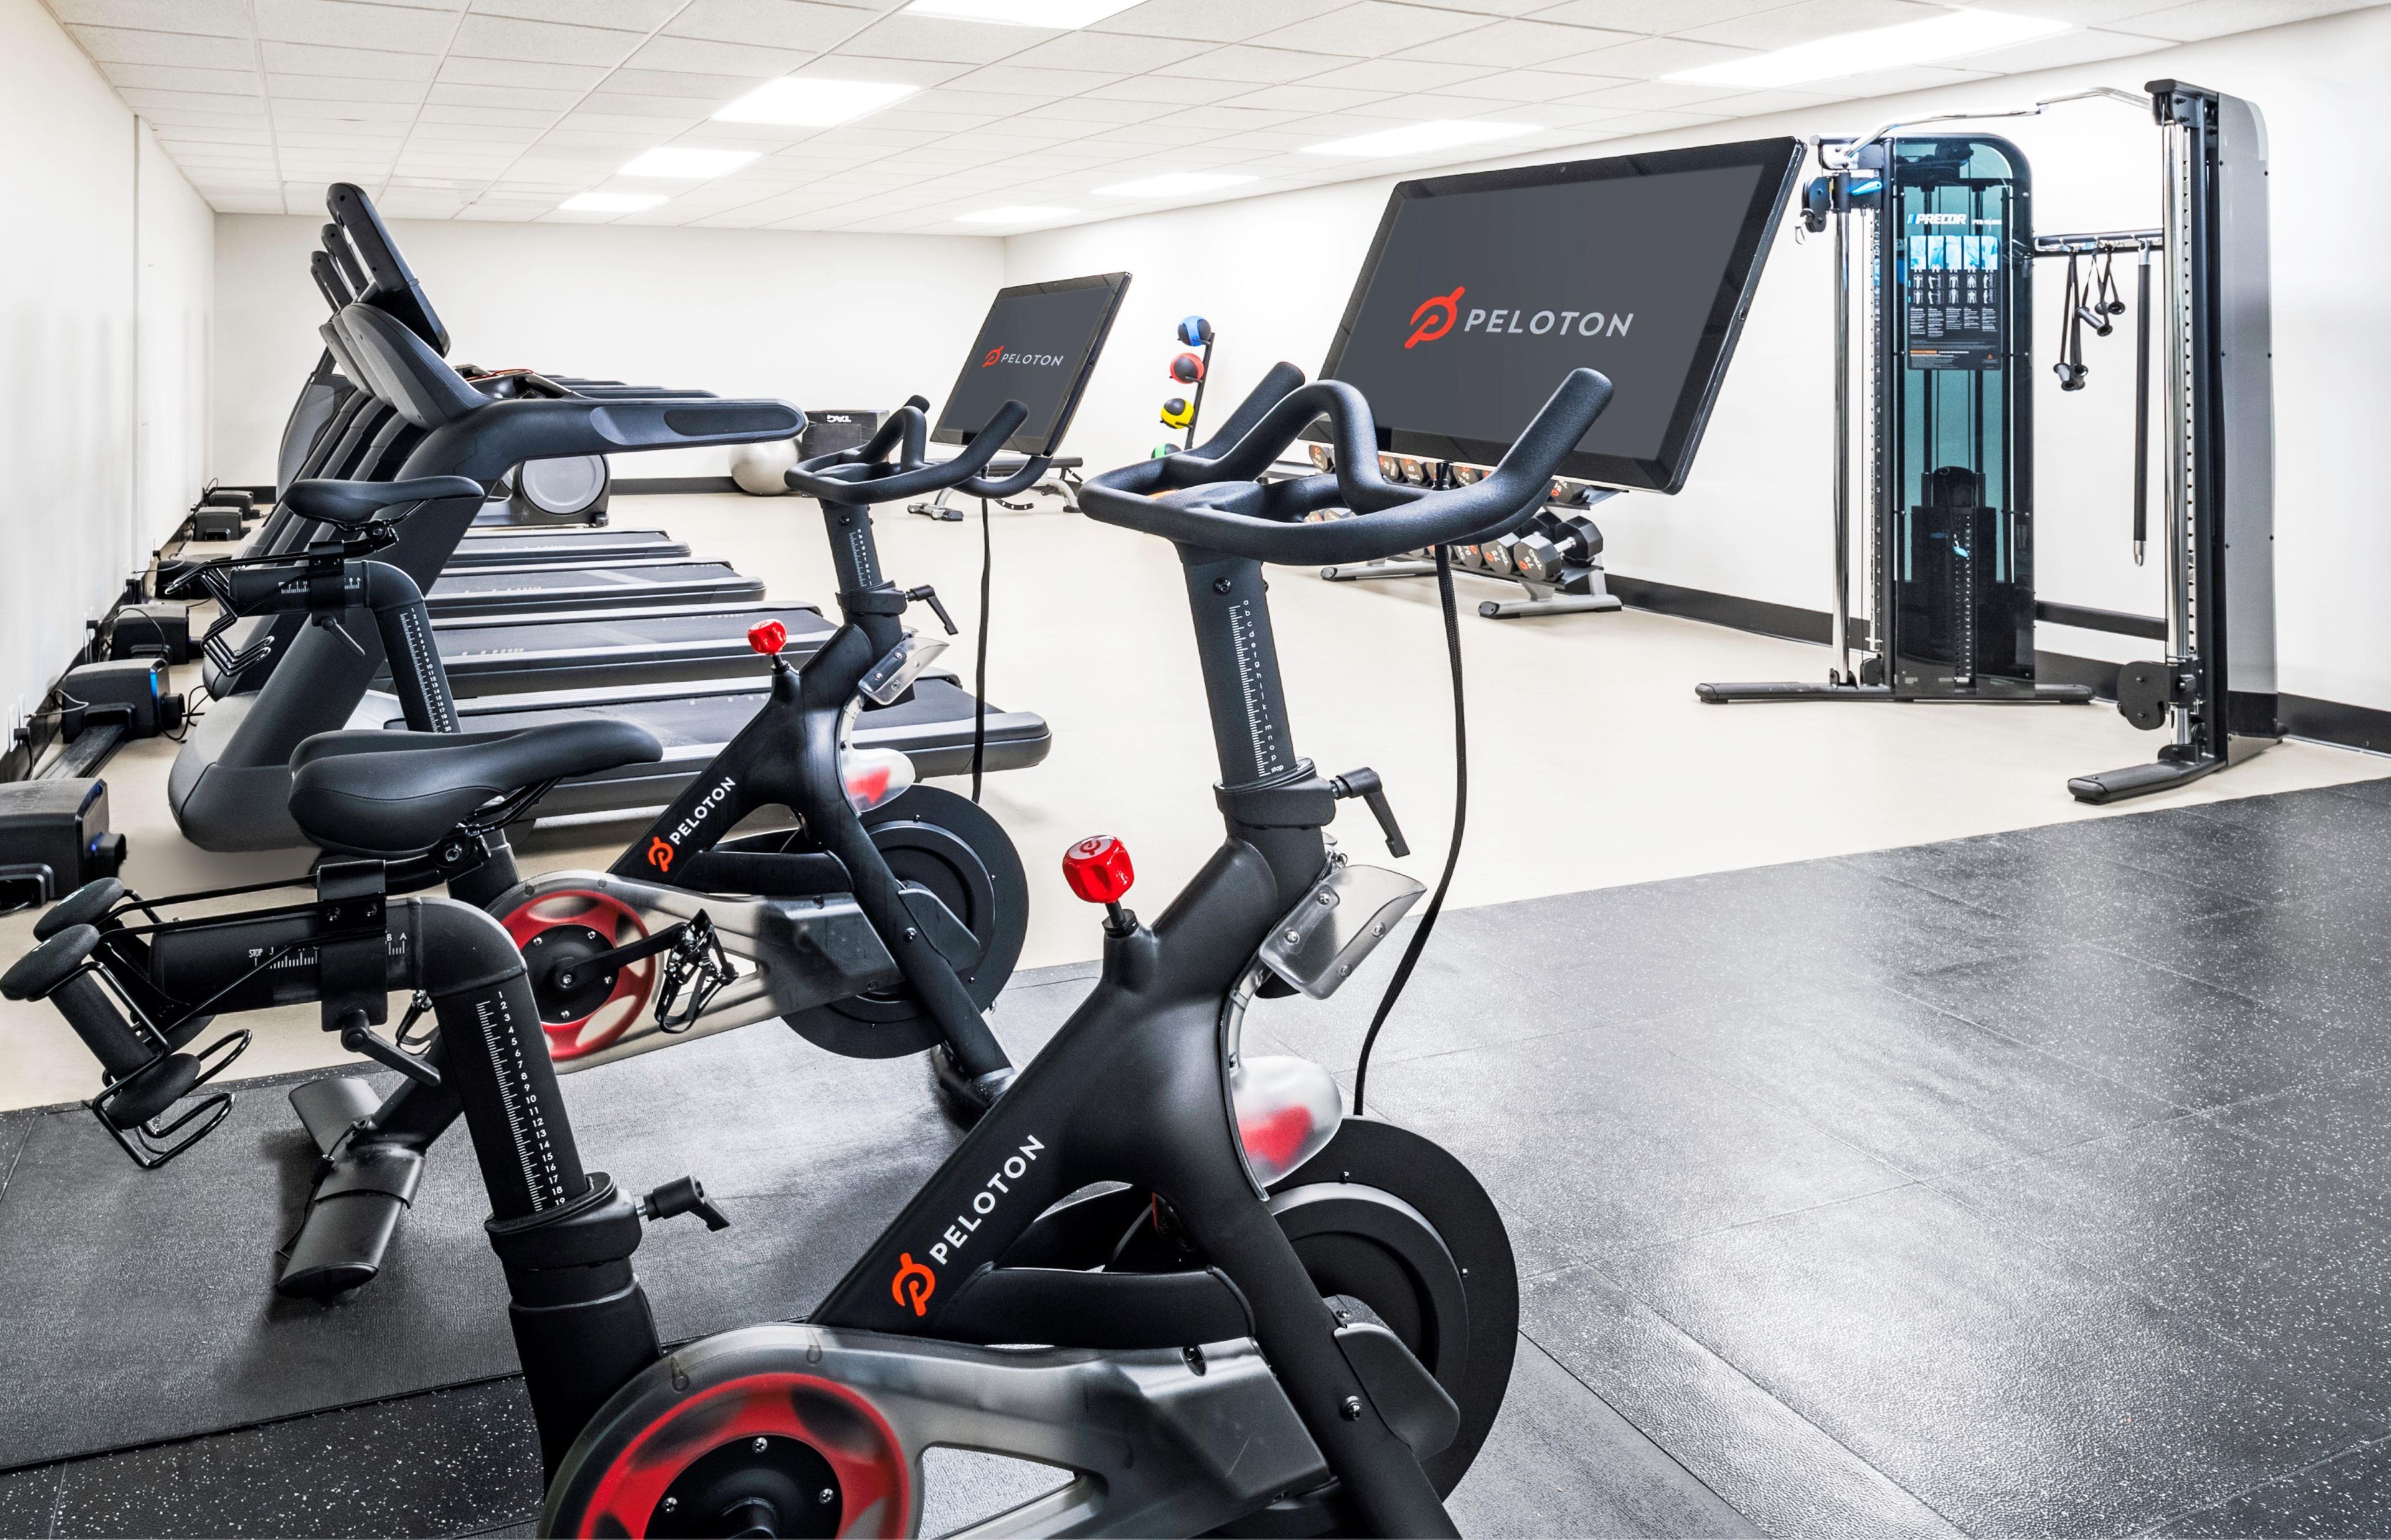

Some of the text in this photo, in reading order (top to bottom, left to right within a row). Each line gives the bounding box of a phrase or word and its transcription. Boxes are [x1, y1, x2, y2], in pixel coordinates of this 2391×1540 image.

[1915, 213, 1967, 225] PRECOR
[1463, 308, 1634, 337] PELOTON
[1001, 354, 1064, 367] PELOTON
[826, 415, 852, 423] TAG
[1271, 764, 1284, 773] stop
[669, 776, 736, 845] PELOTON
[386, 934, 393, 942] B
[399, 932, 407, 941] A
[248, 948, 263, 958] STOP
[526, 1094, 537, 1104] 10
[529, 1106, 539, 1115] 11
[532, 1117, 544, 1127] 12
[536, 1129, 547, 1139] 13
[539, 1140, 550, 1150] 14
[542, 1152, 554, 1162] 15
[545, 1163, 557, 1173] 16
[549, 1174, 558, 1184] 17
[552, 1186, 563, 1195] 18
[928, 1134, 1045, 1265] PELOTON
